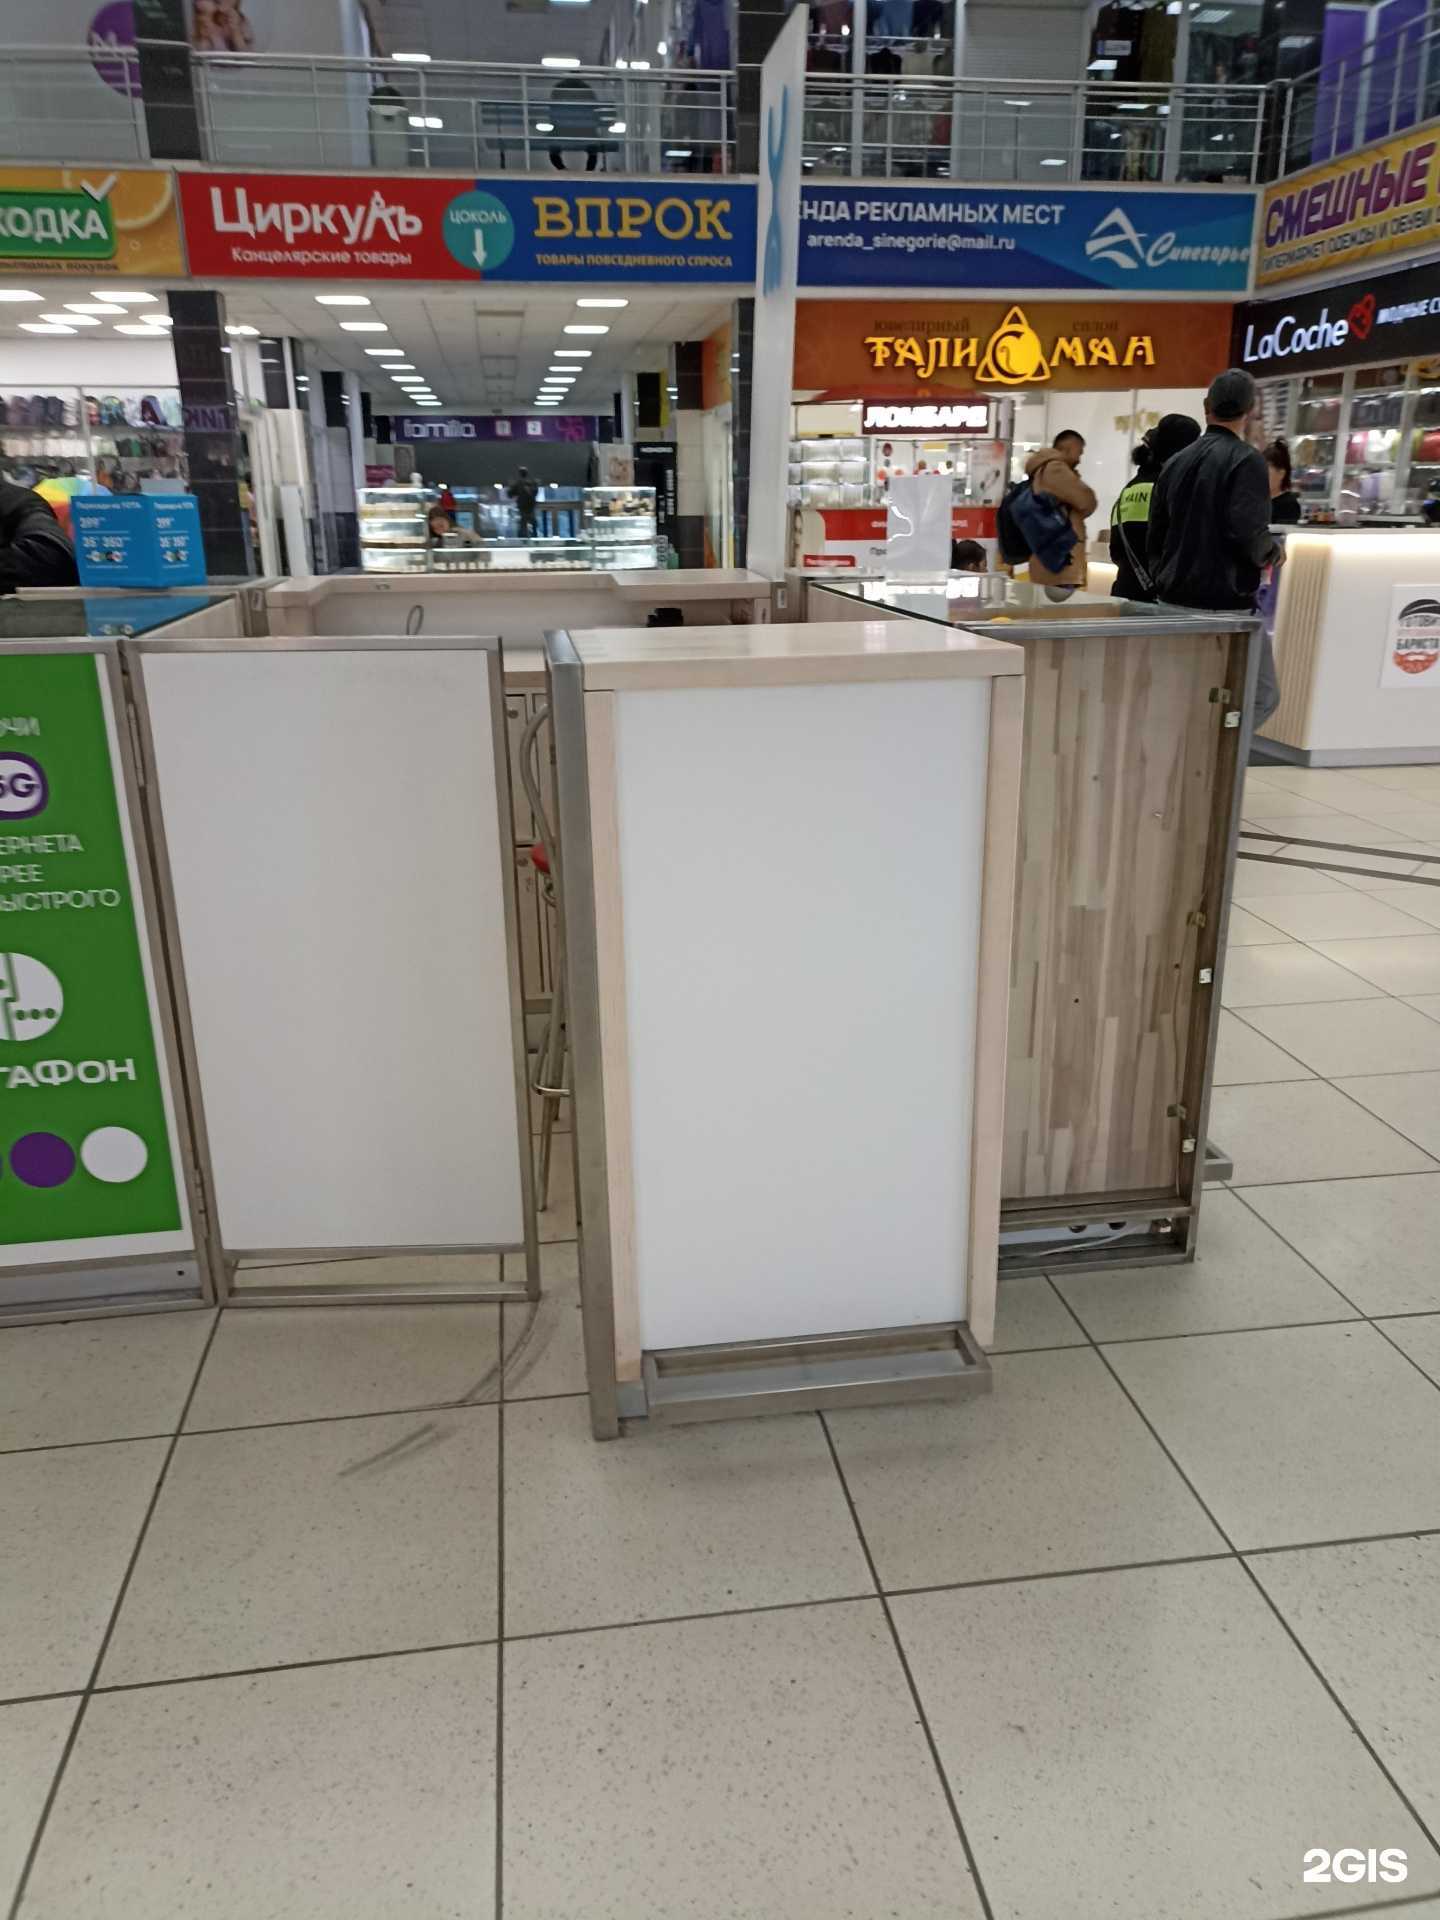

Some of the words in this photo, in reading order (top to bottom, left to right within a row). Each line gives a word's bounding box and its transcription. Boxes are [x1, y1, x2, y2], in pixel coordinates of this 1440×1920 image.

[1264, 142, 1437, 248] СМЕШНЫЕ
[210, 187, 423, 244] Циркуль
[449, 209, 507, 225] ЦОКОЛЬ
[532, 196, 733, 240] ВПРОК
[797, 200, 850, 222] НДА
[854, 202, 999, 224] РЕКЛАМНЫХ
[1002, 205, 1065, 225] МЕСТ
[806, 232, 1016, 252] arenda_sinegorie@mail.ru
[232, 248, 351, 265] Канцелярские
[354, 252, 412, 266] товары
[535, 254, 585, 266] ТОВАРЫ
[586, 255, 686, 267] ПОВСЕДНЕВНОГО
[687, 256, 733, 267] СПРОСА
[1243, 308, 1349, 362] LaCoche
